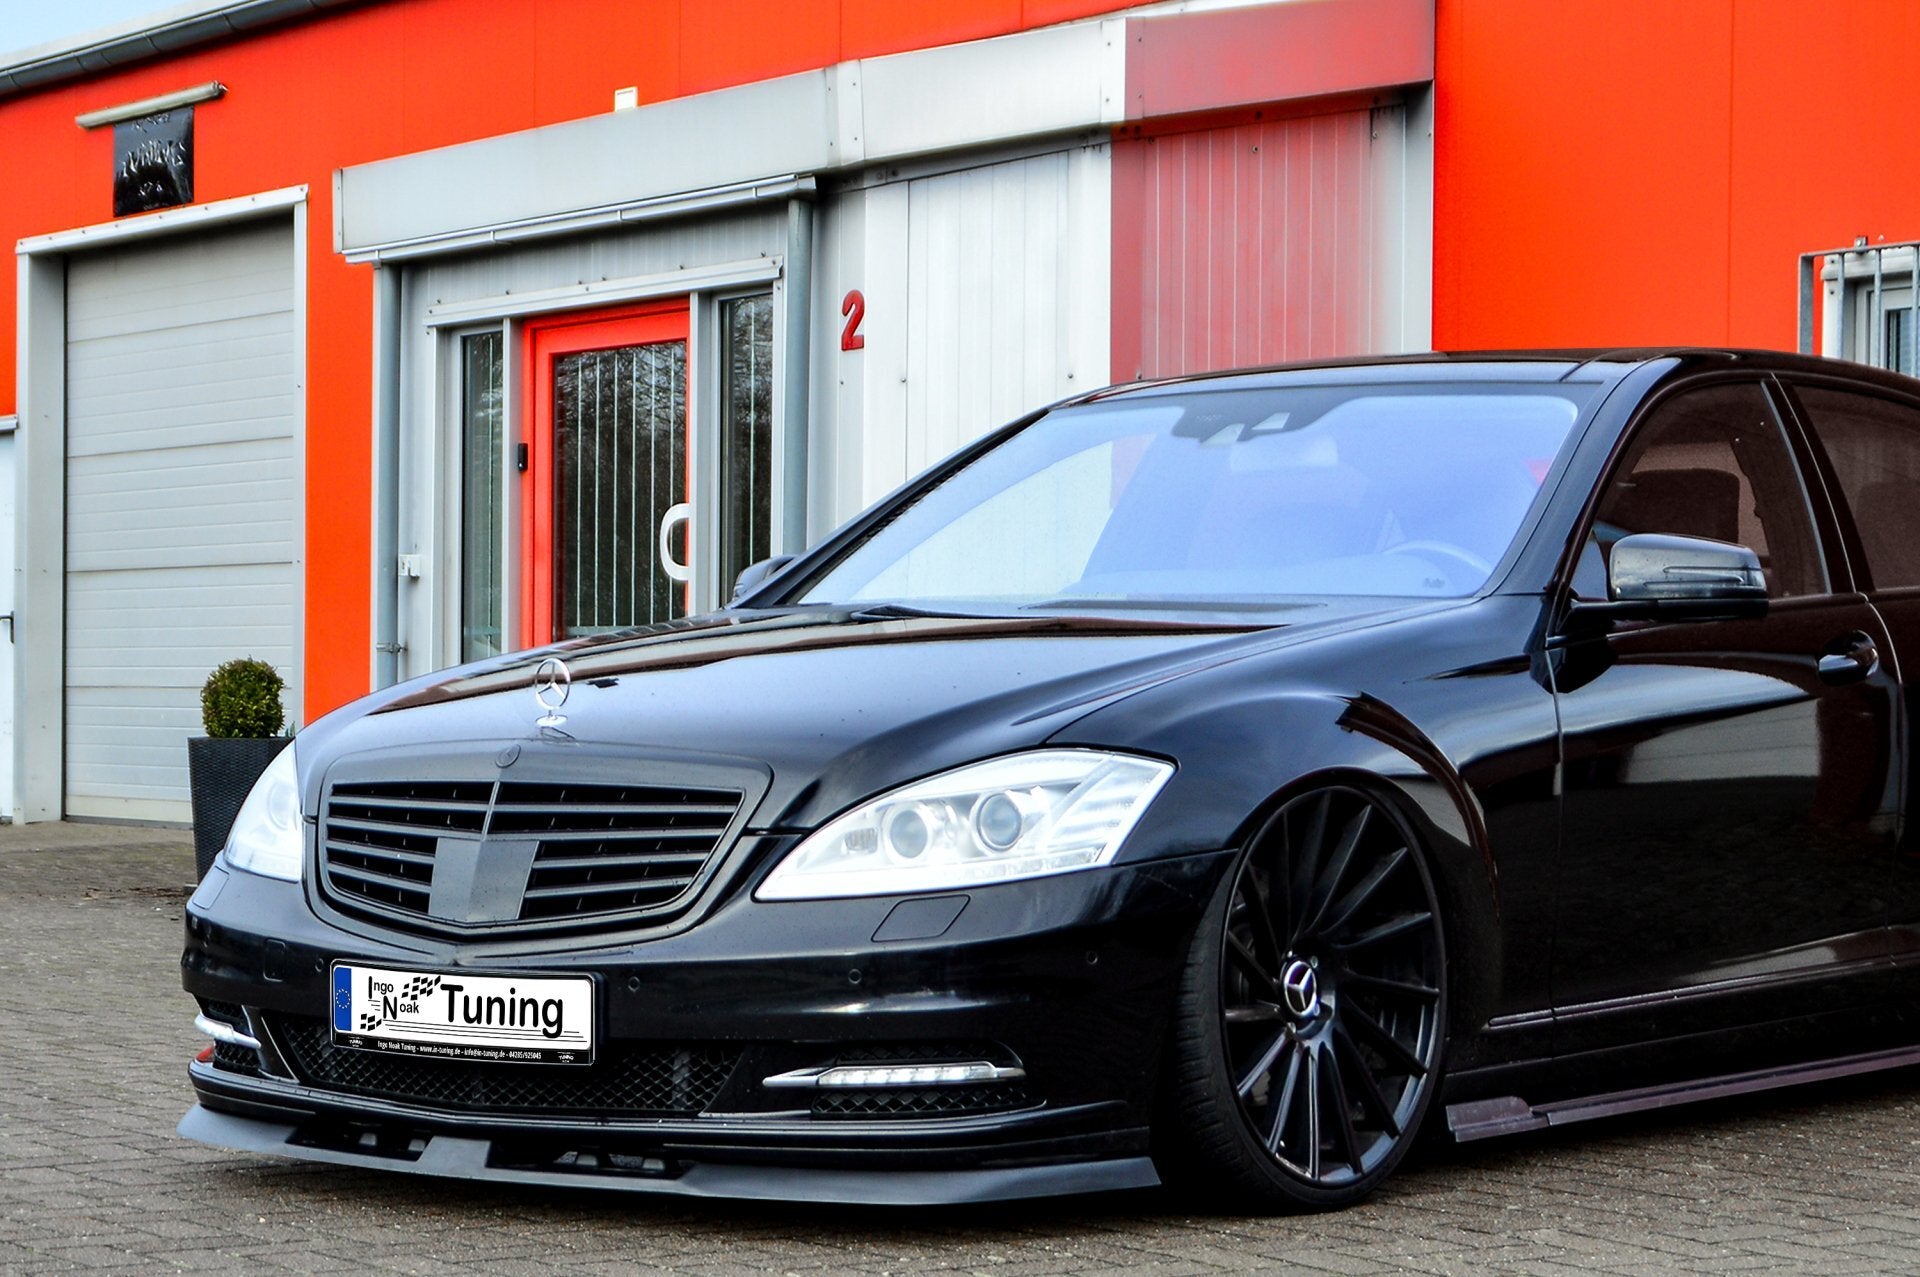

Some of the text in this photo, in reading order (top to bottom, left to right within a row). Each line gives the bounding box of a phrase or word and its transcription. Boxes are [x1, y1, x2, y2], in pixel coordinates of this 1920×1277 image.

[841, 288, 865, 352] 2
[368, 975, 394, 1000] Ingo
[383, 995, 420, 1021] Noak
[440, 983, 563, 1039] Tuning
[401, 1042, 416, 1053] Tuning
